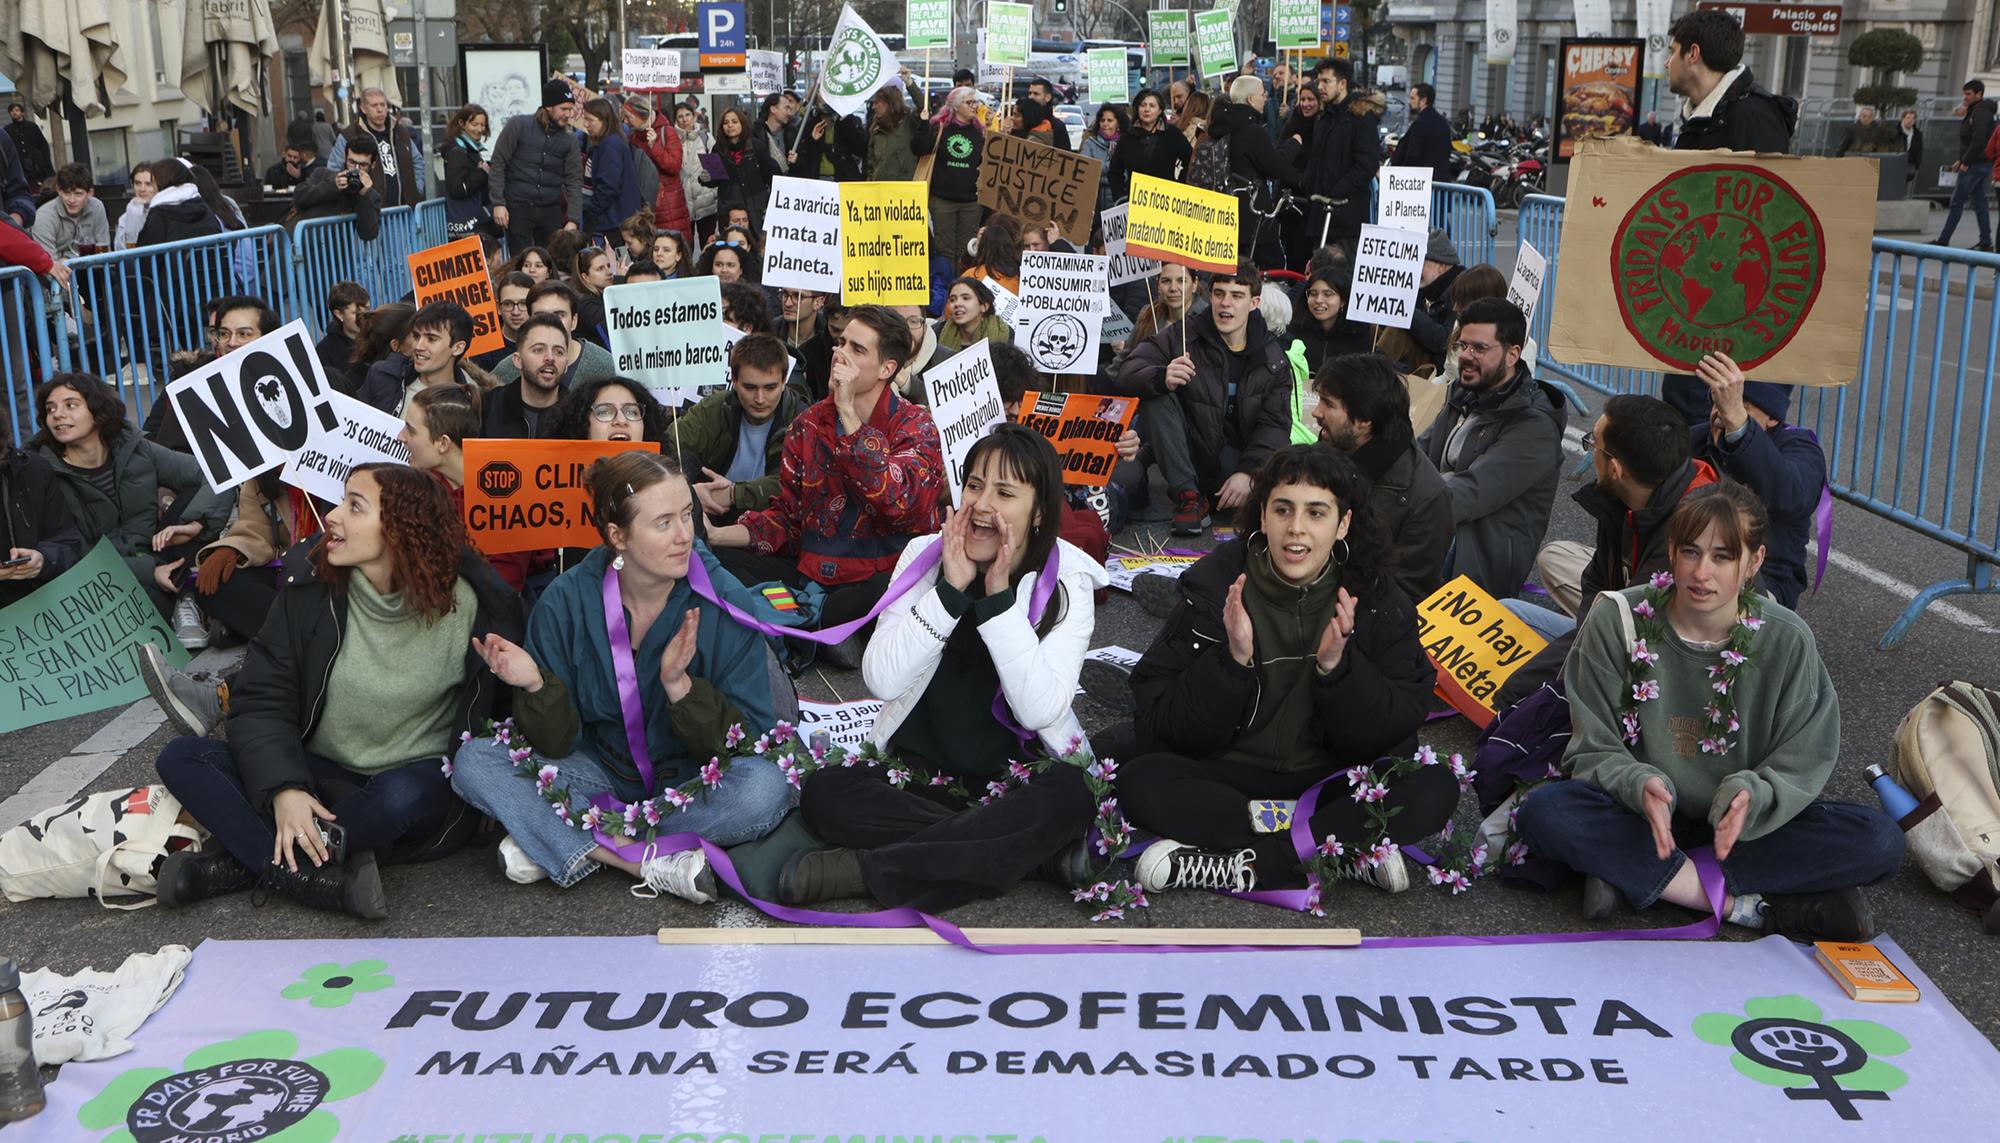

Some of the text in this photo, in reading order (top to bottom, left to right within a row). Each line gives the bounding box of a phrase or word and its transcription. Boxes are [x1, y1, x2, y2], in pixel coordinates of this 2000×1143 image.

[910, 2, 946, 11] SAVE
[1292, 5, 1317, 15] PLANET
[1772, 9, 1837, 20] Palacio de
[351, 13, 376, 27] borit
[708, 9, 735, 47] P
[910, 20, 947, 29] SAVE
[990, 15, 1026, 25] SAVE
[1151, 21, 1185, 31] SAVE
[1199, 22, 1229, 35] SAVE
[1279, 16, 1317, 26] SAVE
[1791, 21, 1836, 32] Cibeles
[720, 39, 735, 47] 24h
[989, 33, 1026, 45] SAVE
[1152, 39, 1186, 48] SAVE
[1202, 41, 1232, 55] SAVE
[624, 52, 650, 68] Change
[651, 57, 666, 68] your
[853, 33, 879, 92] FOR FUTURE
[1091, 58, 1124, 69] SAVE
[1567, 47, 1636, 75] CHEESY
[625, 71, 679, 85] no your climate.
[1091, 75, 1125, 85] SAVE
[986, 137, 1089, 184] CLIMATE
[987, 162, 1078, 205] JUSTICE
[1389, 174, 1426, 192] Rescatar
[775, 190, 840, 217] La avaricia
[846, 199, 925, 226] Ya, tan violada,
[997, 185, 1079, 234] NOW
[1131, 184, 1237, 229] Los ricos contaminan más,
[1386, 201, 1427, 219] al Planeta,
[771, 224, 838, 246] mata al
[846, 234, 925, 258] la madre Tierra
[1128, 220, 1236, 260] matando más a los demás.
[1362, 238, 1418, 261] ESTE CLIMA
[1625, 176, 1810, 344] FRIDAYS FOR FUTURE
[415, 250, 484, 288] CLIMATE
[767, 251, 834, 276] planeta.
[1024, 255, 1094, 272] +CONTAMINAR
[848, 269, 926, 297] sus hijos mata.
[1021, 275, 1091, 293] +CONSUMIR
[1358, 265, 1413, 290] ENFERMA
[610, 301, 717, 330] Todos estamos
[1020, 295, 1090, 313] +POBLACIÓN
[1355, 293, 1408, 317] Y MATA.
[1524, 301, 1535, 320] al
[1657, 316, 1734, 353] MADRID
[619, 354, 632, 372] en
[634, 348, 643, 370] el
[645, 346, 682, 370] mismo
[685, 342, 723, 366] barco.
[932, 355, 990, 408] Protégete
[176, 332, 340, 486] NO!
[943, 391, 1000, 455] protegiendo
[1058, 415, 1124, 443] planeta
[296, 449, 327, 473] para
[1059, 448, 1114, 476] lota!
[484, 471, 516, 489] STOP
[469, 501, 571, 531] CHAOS,
[16, 571, 124, 651] A CALENTAR
[1427, 590, 1532, 666] ¡No hay
[0, 656, 26, 683] UE
[25, 649, 71, 678] SEA
[71, 618, 107, 658] TU
[18, 684, 58, 711] AL
[384, 990, 1673, 1038] FUTURO ECOFEMINISTA
[414, 1042, 1629, 1085] MAÑANA SERÁ DEMASIADO TARDE
[220, 1061, 277, 1078] FOR
[277, 1065, 319, 1113] FUTURE
